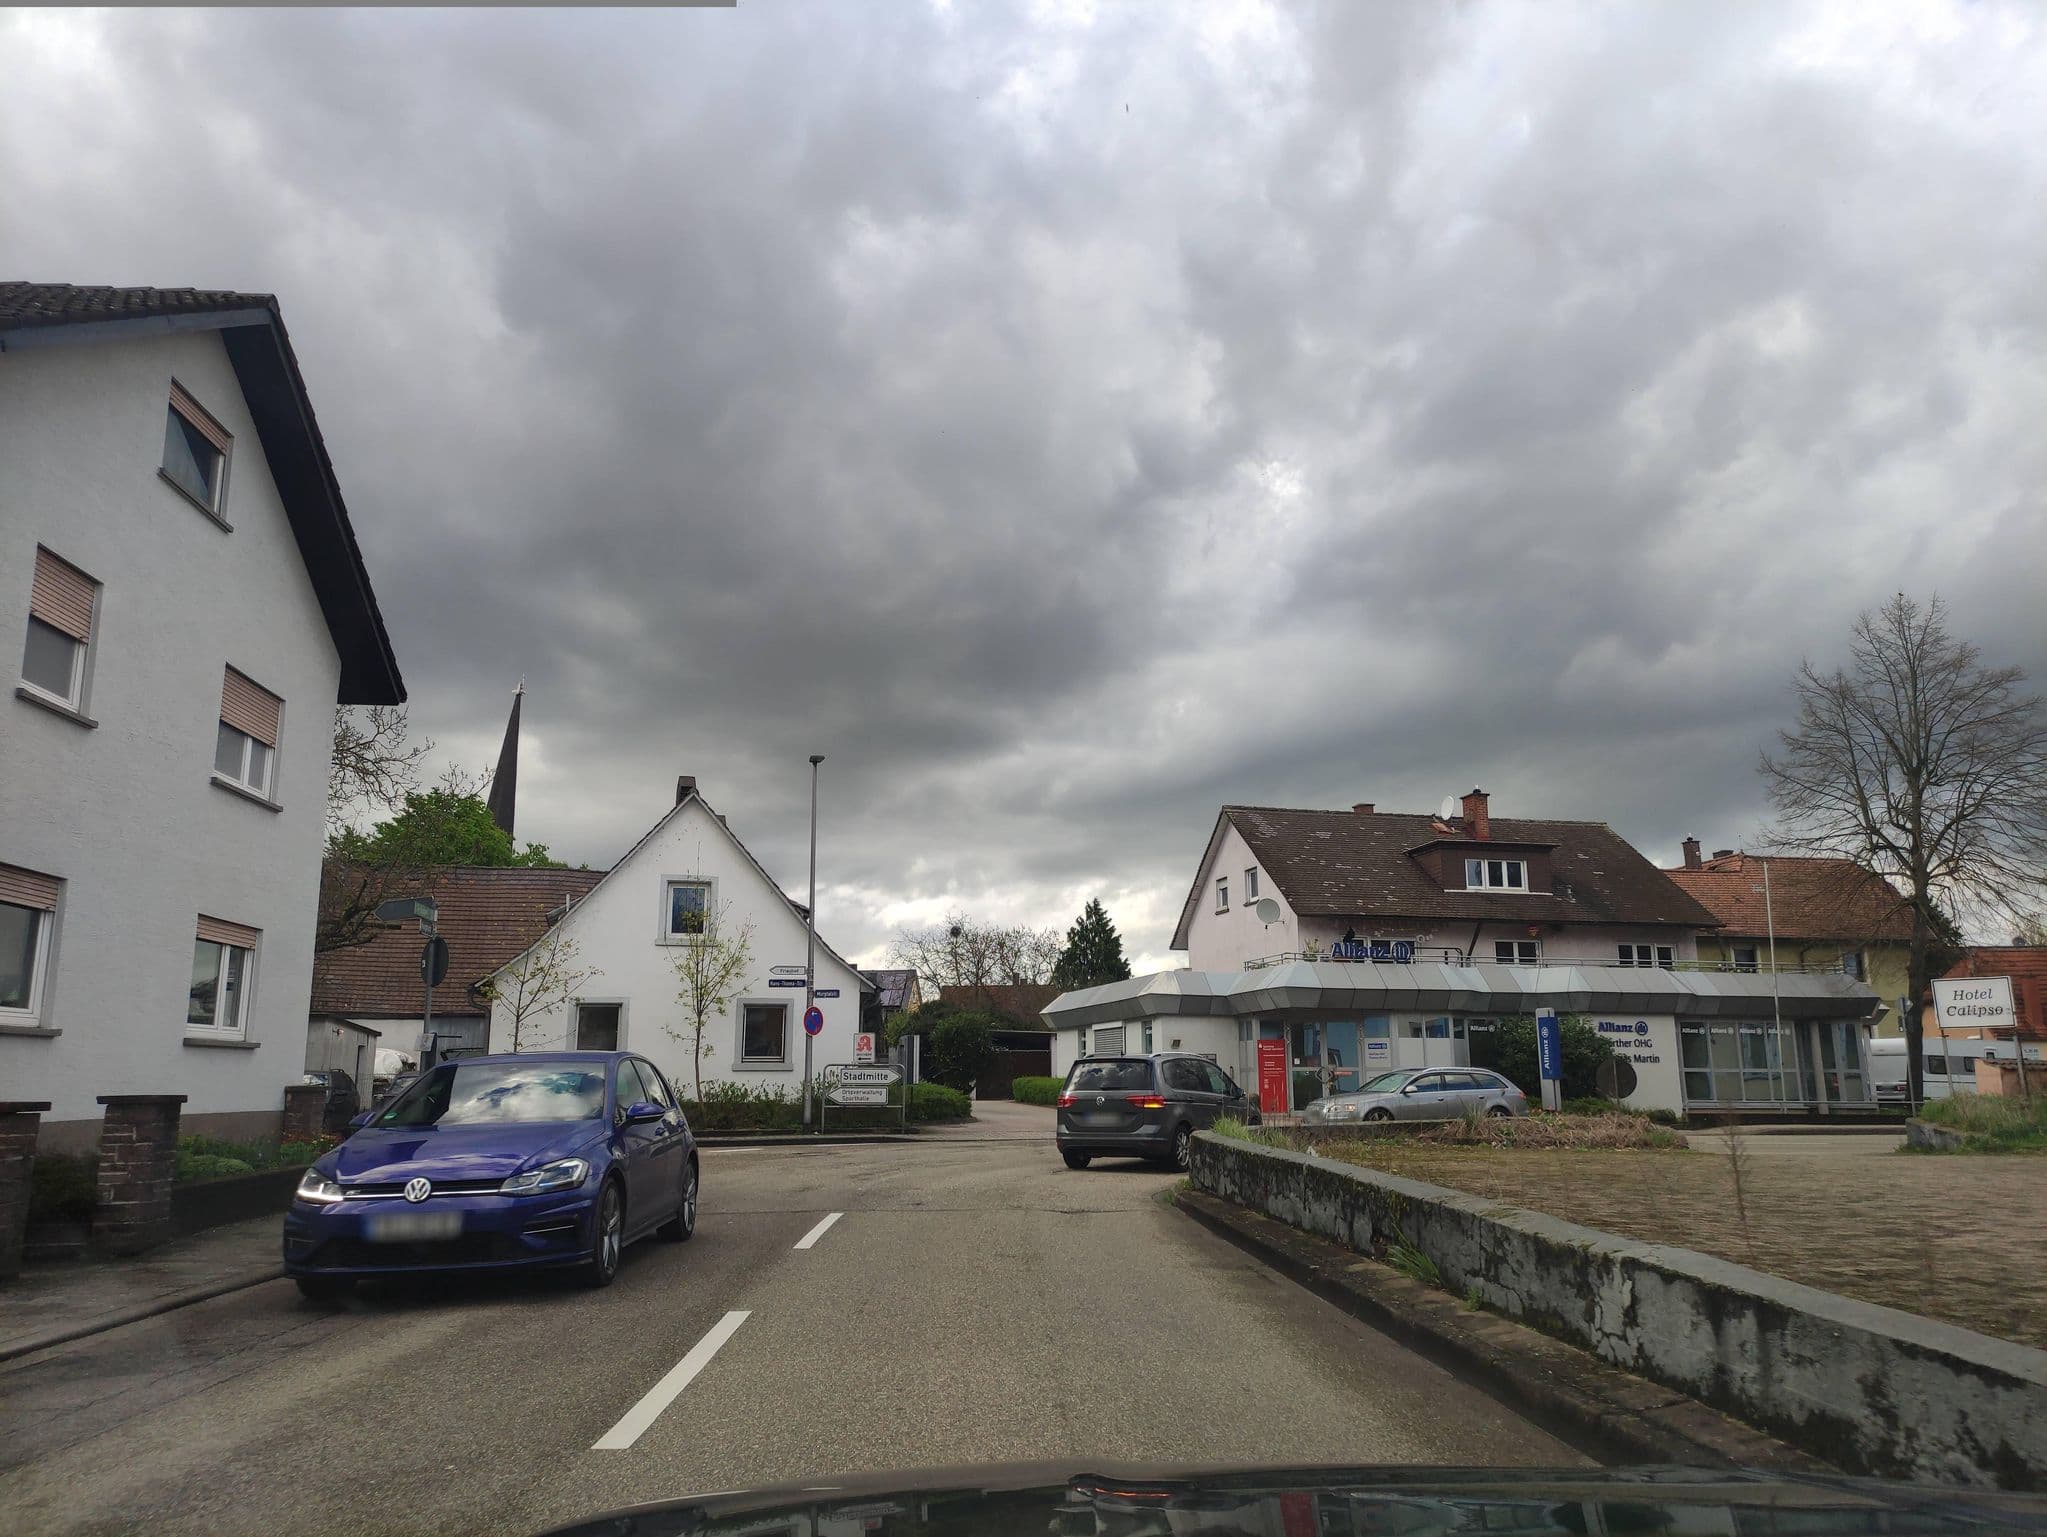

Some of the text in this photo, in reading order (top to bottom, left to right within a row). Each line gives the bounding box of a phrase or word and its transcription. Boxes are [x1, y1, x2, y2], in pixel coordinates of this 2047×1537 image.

[1331, 942, 1389, 959] Allianz
[1953, 988, 1993, 1001] Hotel
[1946, 1004, 2004, 1017] Calipso
[1598, 1021, 1634, 1033] Allianz
[1633, 1038, 1653, 1048] OHG
[1633, 1053, 1660, 1064] Martin
[842, 1071, 889, 1081] Stadtmitte
